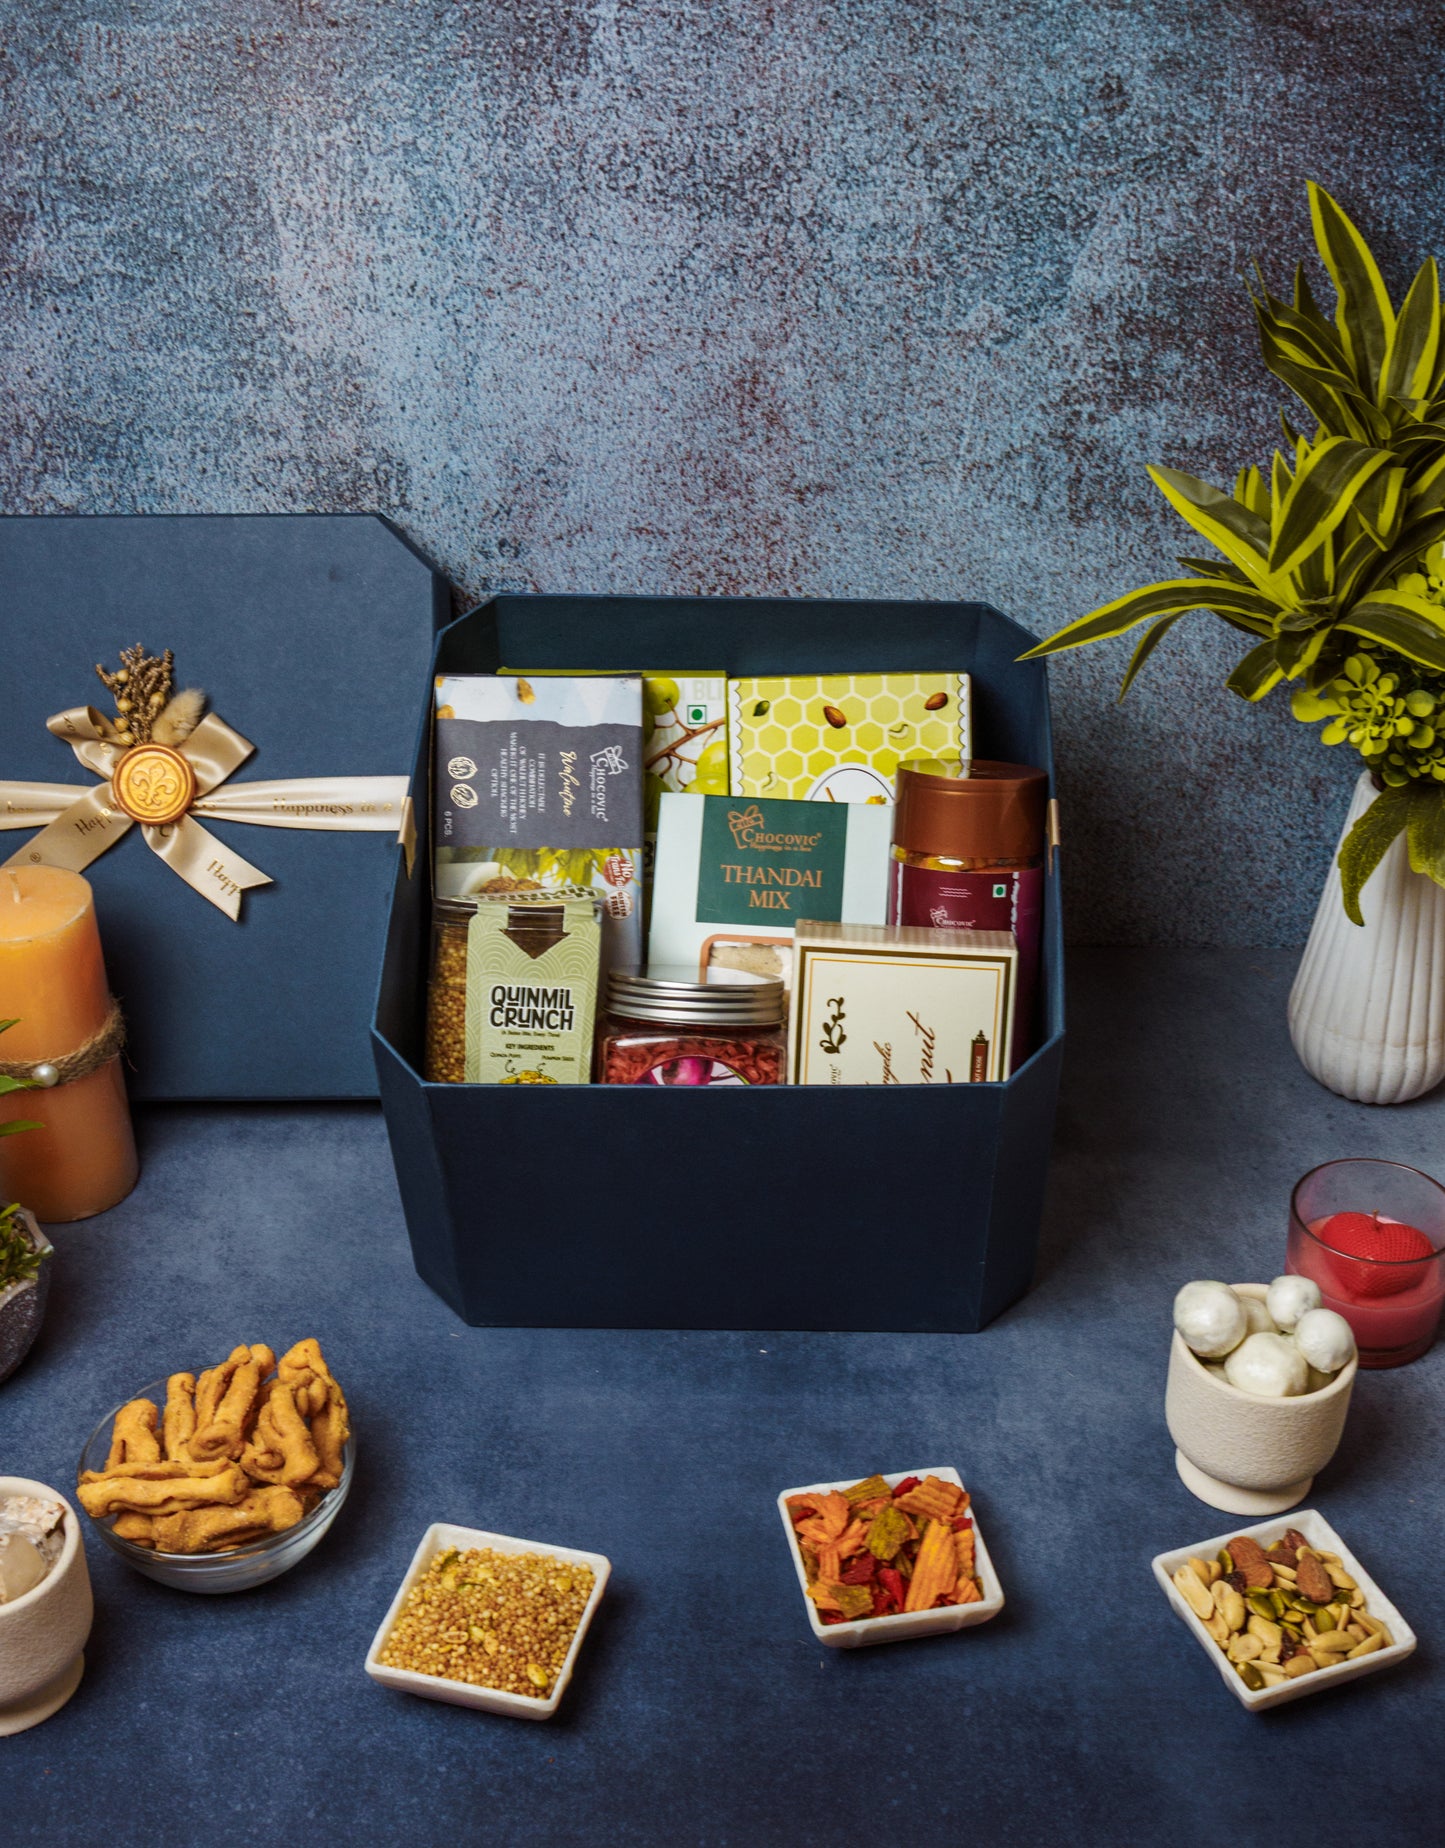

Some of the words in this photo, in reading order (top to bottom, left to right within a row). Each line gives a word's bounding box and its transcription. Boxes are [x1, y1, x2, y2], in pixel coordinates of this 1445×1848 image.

[596, 758, 608, 819] CHOCOVIC
[741, 828, 818, 846] CHOCOVIC
[720, 863, 823, 888] THANDAI
[748, 889, 792, 910] MIX
[490, 1007, 574, 1031] CRUNCH
[906, 1010, 935, 1083] nut
[873, 1040, 898, 1084] ngelic
